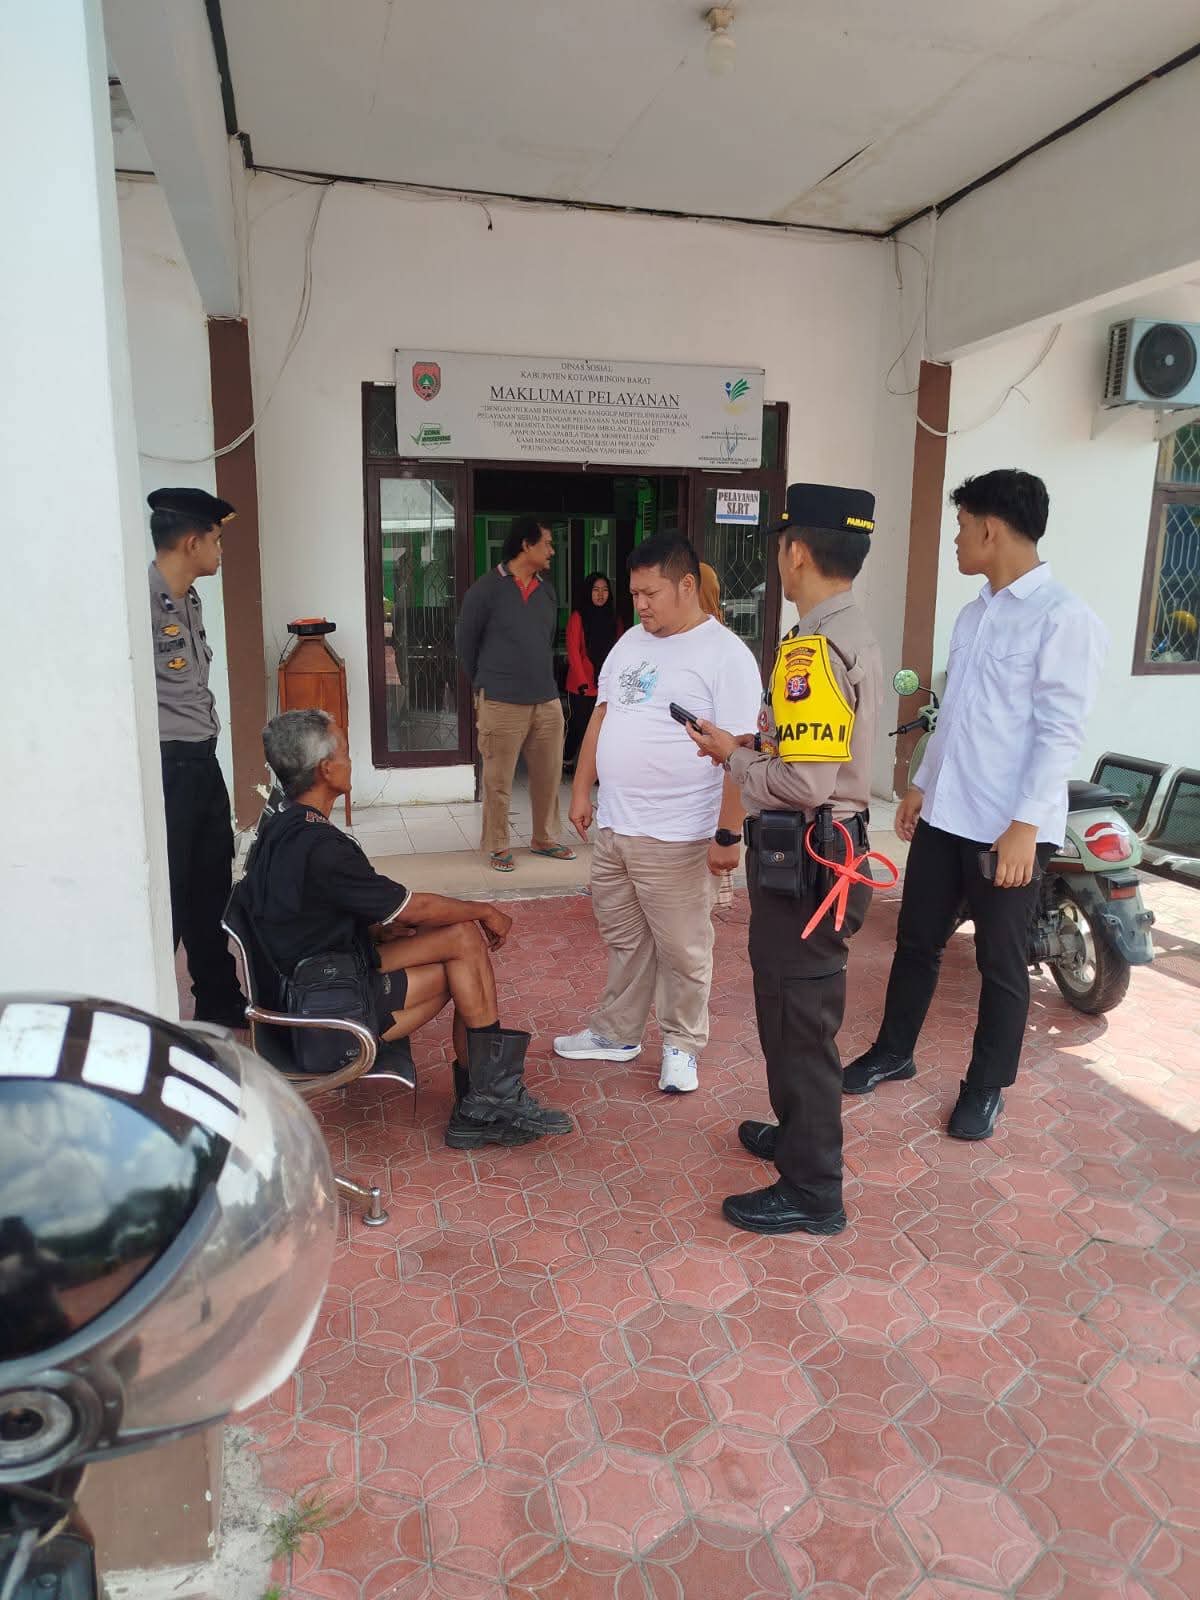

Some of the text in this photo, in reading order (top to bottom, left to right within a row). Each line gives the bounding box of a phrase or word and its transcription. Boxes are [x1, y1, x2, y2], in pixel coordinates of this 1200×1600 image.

[560, 362, 613, 373] DINAS SOSIAL
[520, 371, 652, 385] KABUPATEN KOTAWARINGIN BARAT
[489, 385, 681, 408] MAKLUMAT PELAYANAN
[718, 491, 759, 503] PELAYANAN
[726, 502, 750, 515] SLRT
